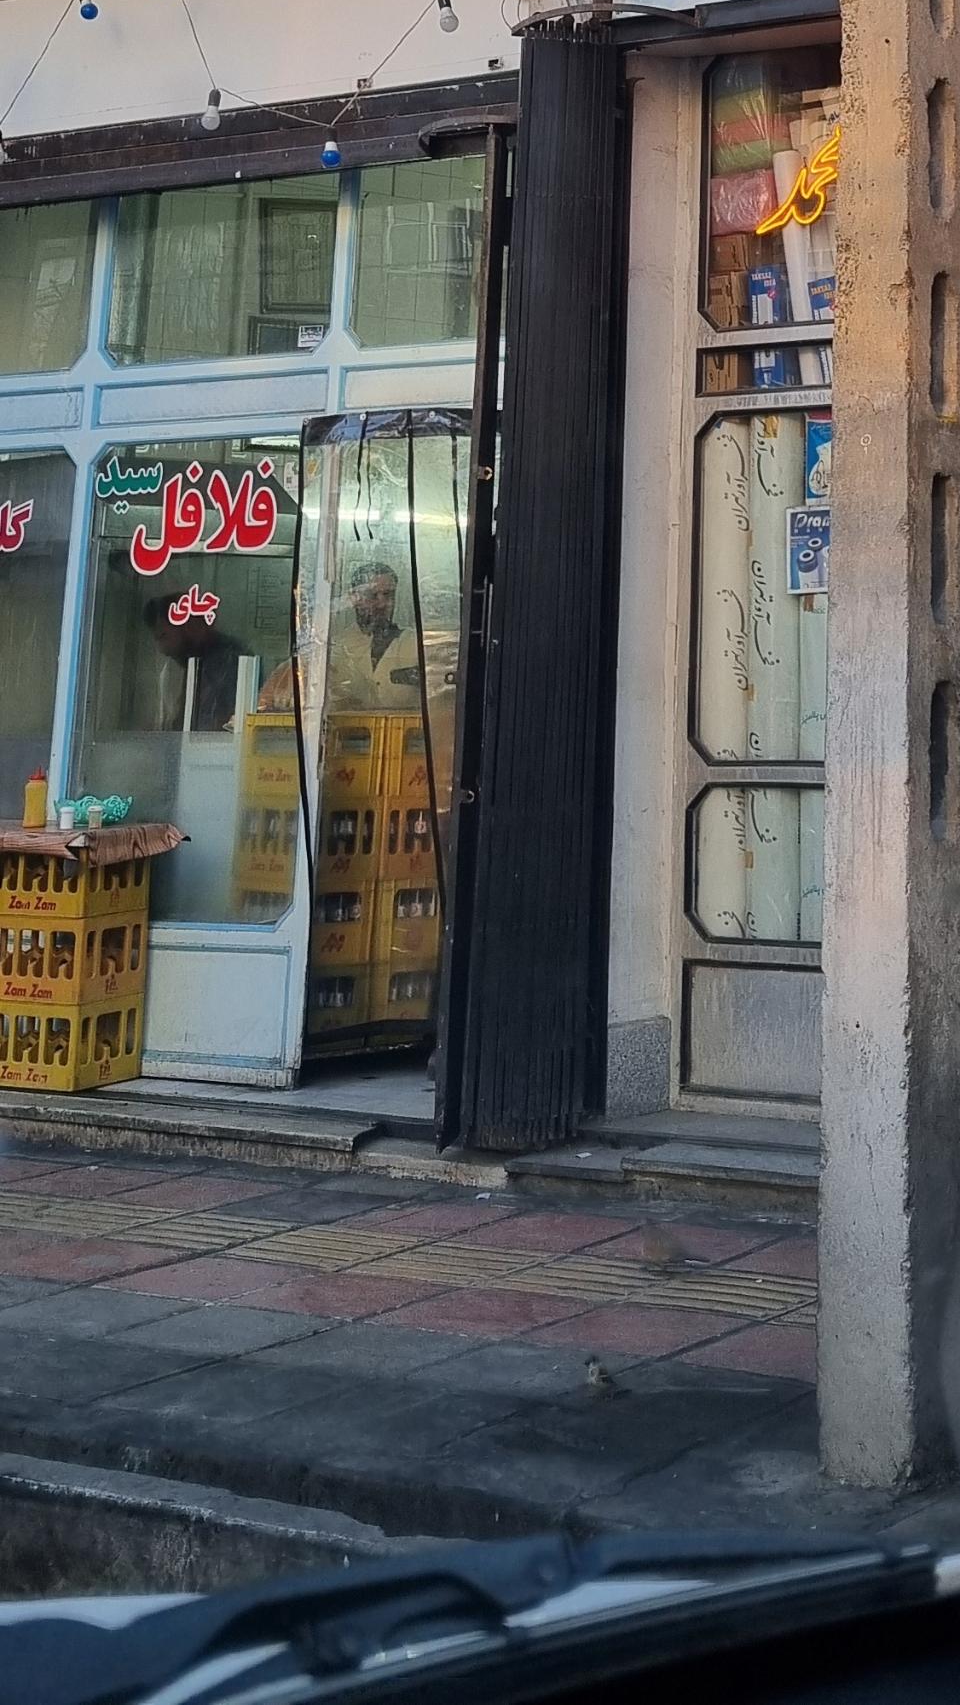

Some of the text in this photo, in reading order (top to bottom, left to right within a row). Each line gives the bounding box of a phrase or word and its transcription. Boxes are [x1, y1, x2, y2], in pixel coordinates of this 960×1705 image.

[95, 455, 164, 514] سید
[130, 456, 278, 576] فلافل
[168, 583, 221, 626] چای
[8, 895, 57, 911] Zam Zam
[4, 981, 53, 999] Zam Zam
[1, 1065, 22, 1080] Zam
